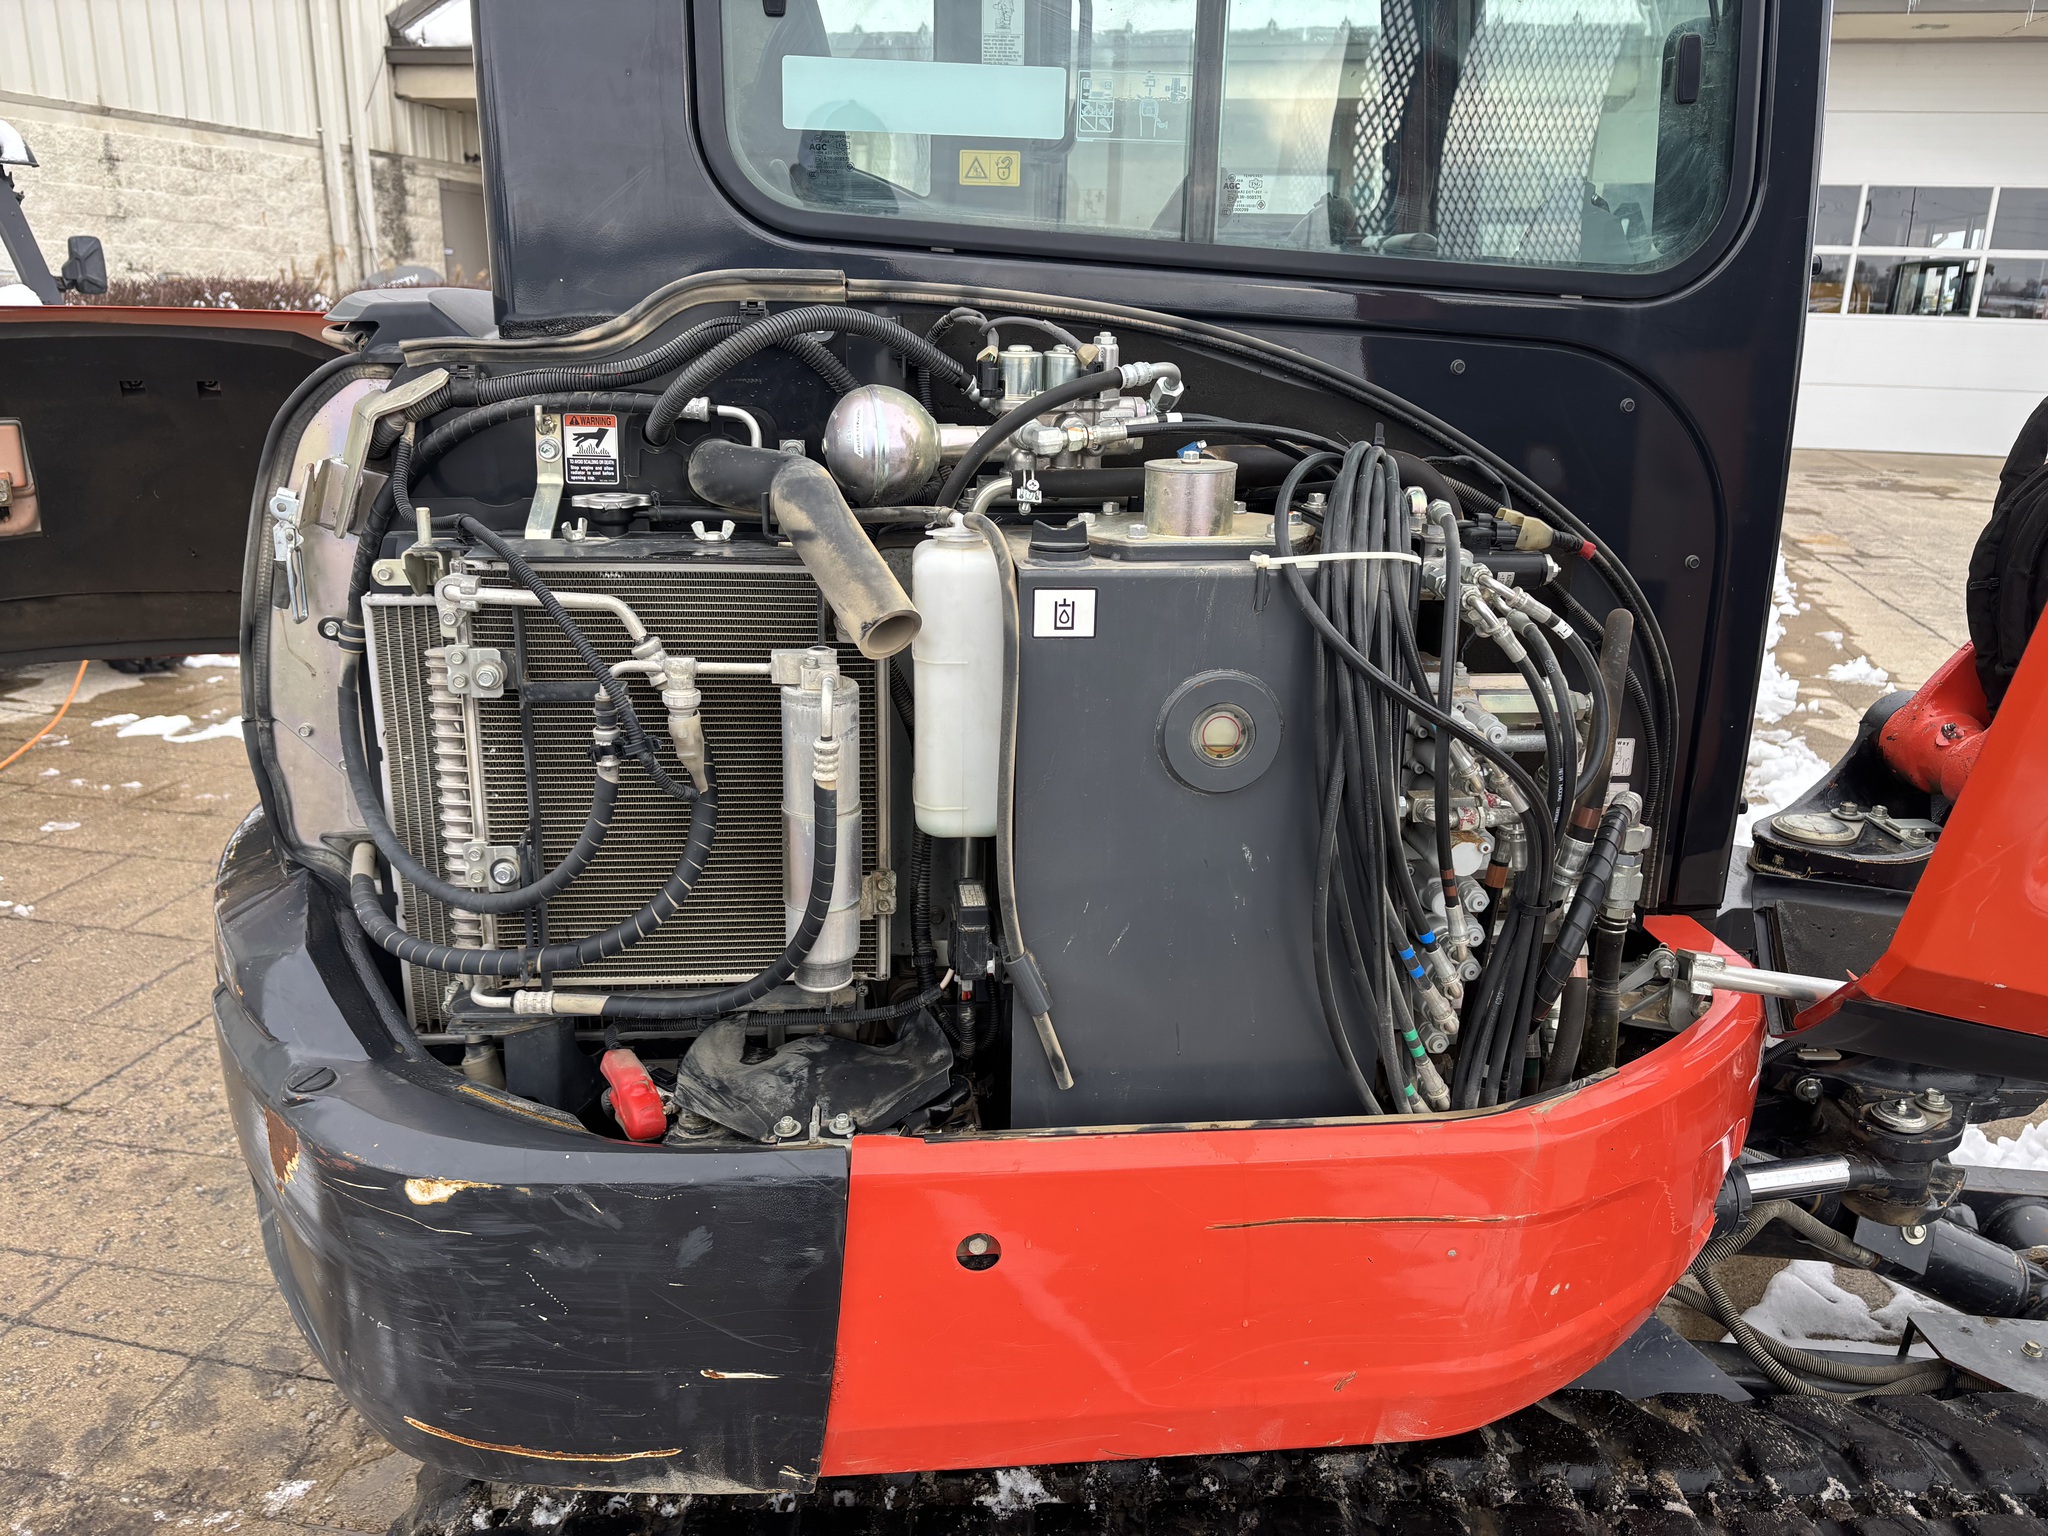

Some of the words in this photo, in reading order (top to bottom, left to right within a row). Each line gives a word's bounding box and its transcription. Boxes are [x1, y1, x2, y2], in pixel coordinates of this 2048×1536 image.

[809, 143, 827, 151] AGC
[1223, 182, 1241, 190] AGC
[580, 416, 611, 425] WARNING
